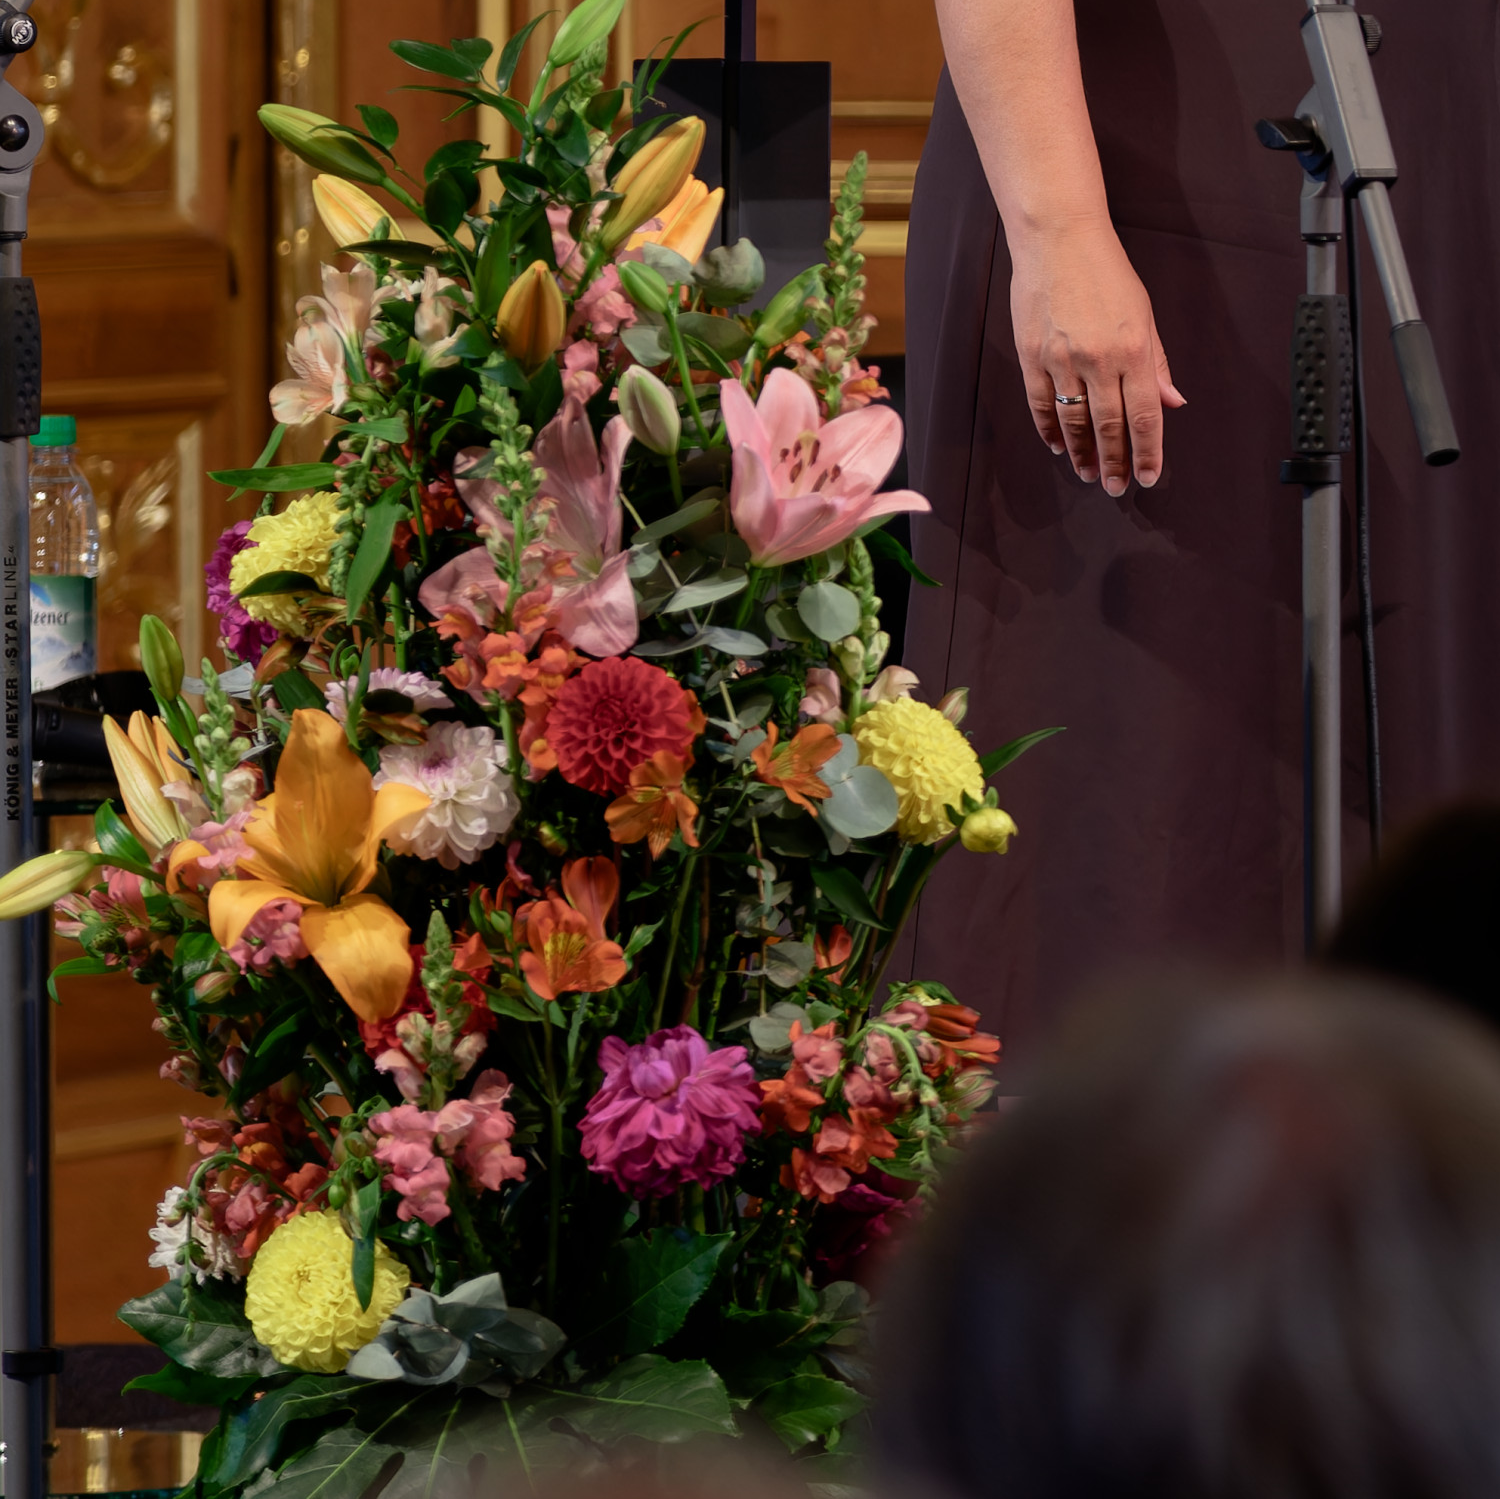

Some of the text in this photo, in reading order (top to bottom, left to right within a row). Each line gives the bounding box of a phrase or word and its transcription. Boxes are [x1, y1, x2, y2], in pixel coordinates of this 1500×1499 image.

[5, 678, 19, 739] MEYER
[7, 745, 20, 757] &
[4, 762, 20, 821] KÖNIG
